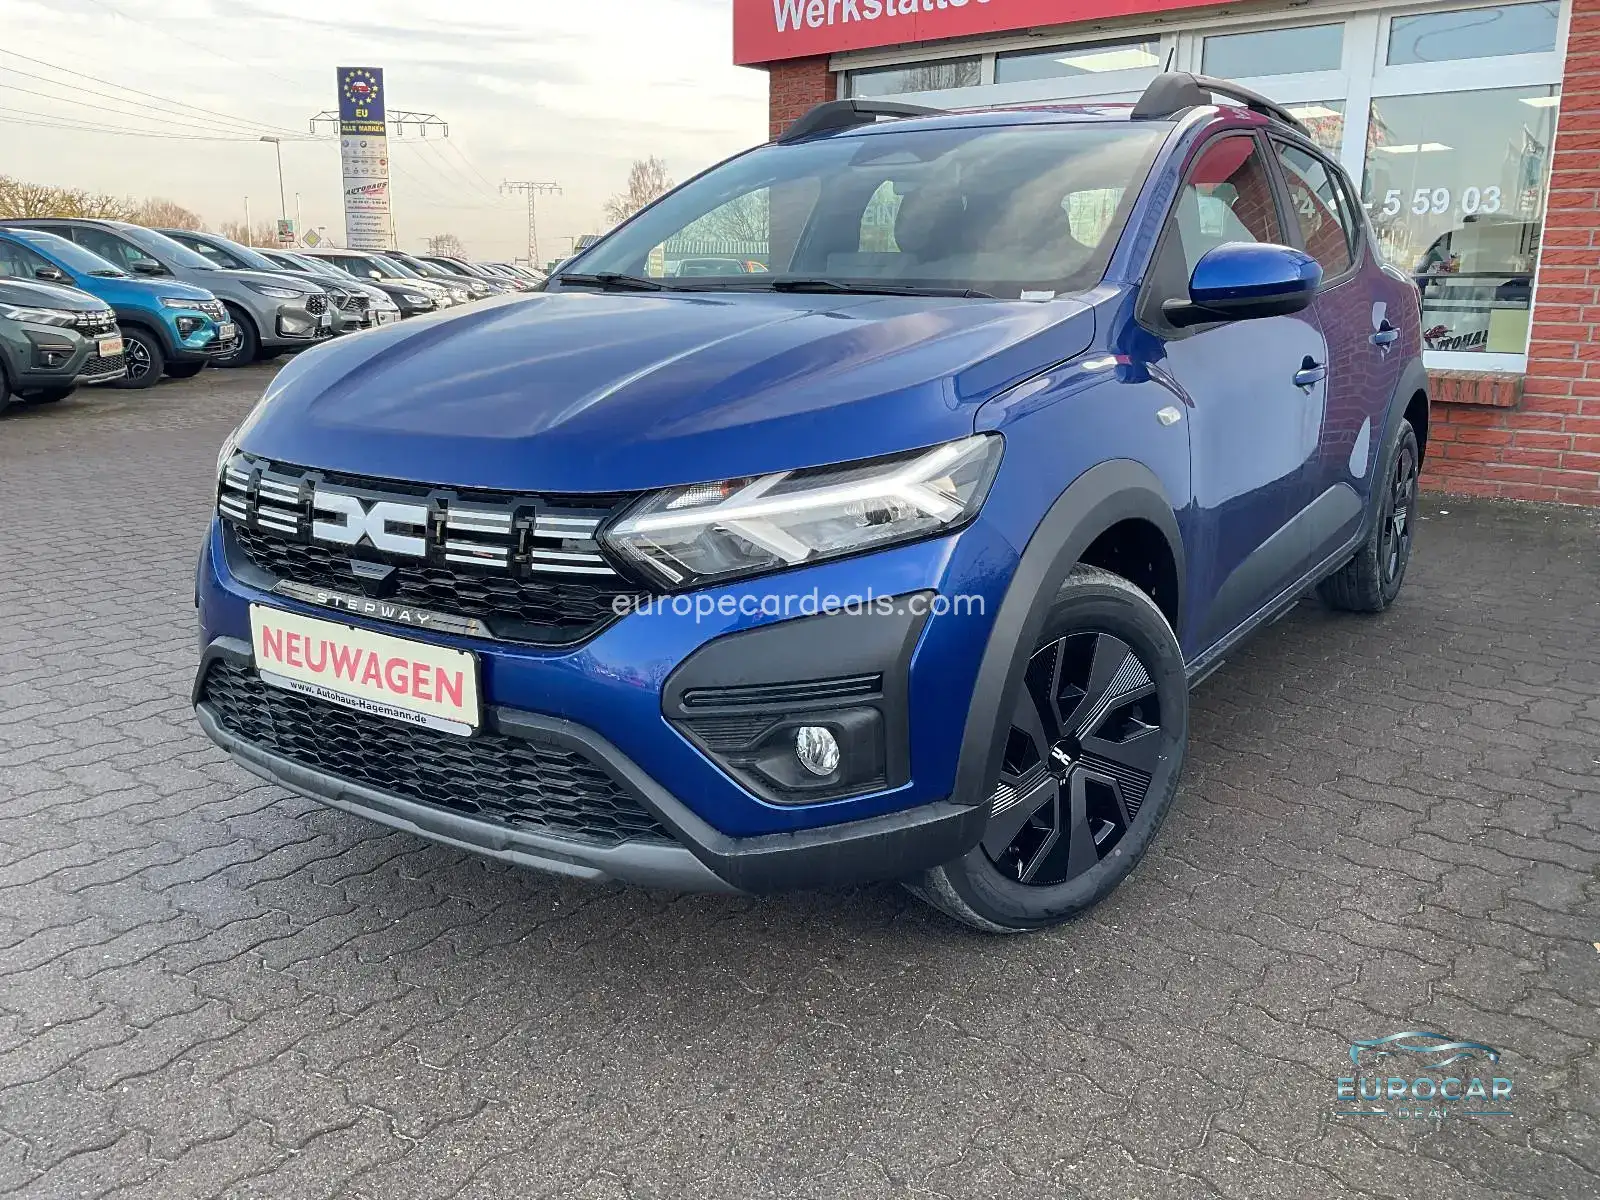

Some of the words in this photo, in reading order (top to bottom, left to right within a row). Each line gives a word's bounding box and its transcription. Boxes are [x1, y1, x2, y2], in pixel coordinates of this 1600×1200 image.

[356, 108, 369, 118] EU
[1382, 189, 1400, 216] 5
[1411, 186, 1451, 215] 59
[1461, 185, 1501, 214] 03
[316, 592, 431, 624] STEPWAY
[262, 624, 464, 708] NEUWAGEN
